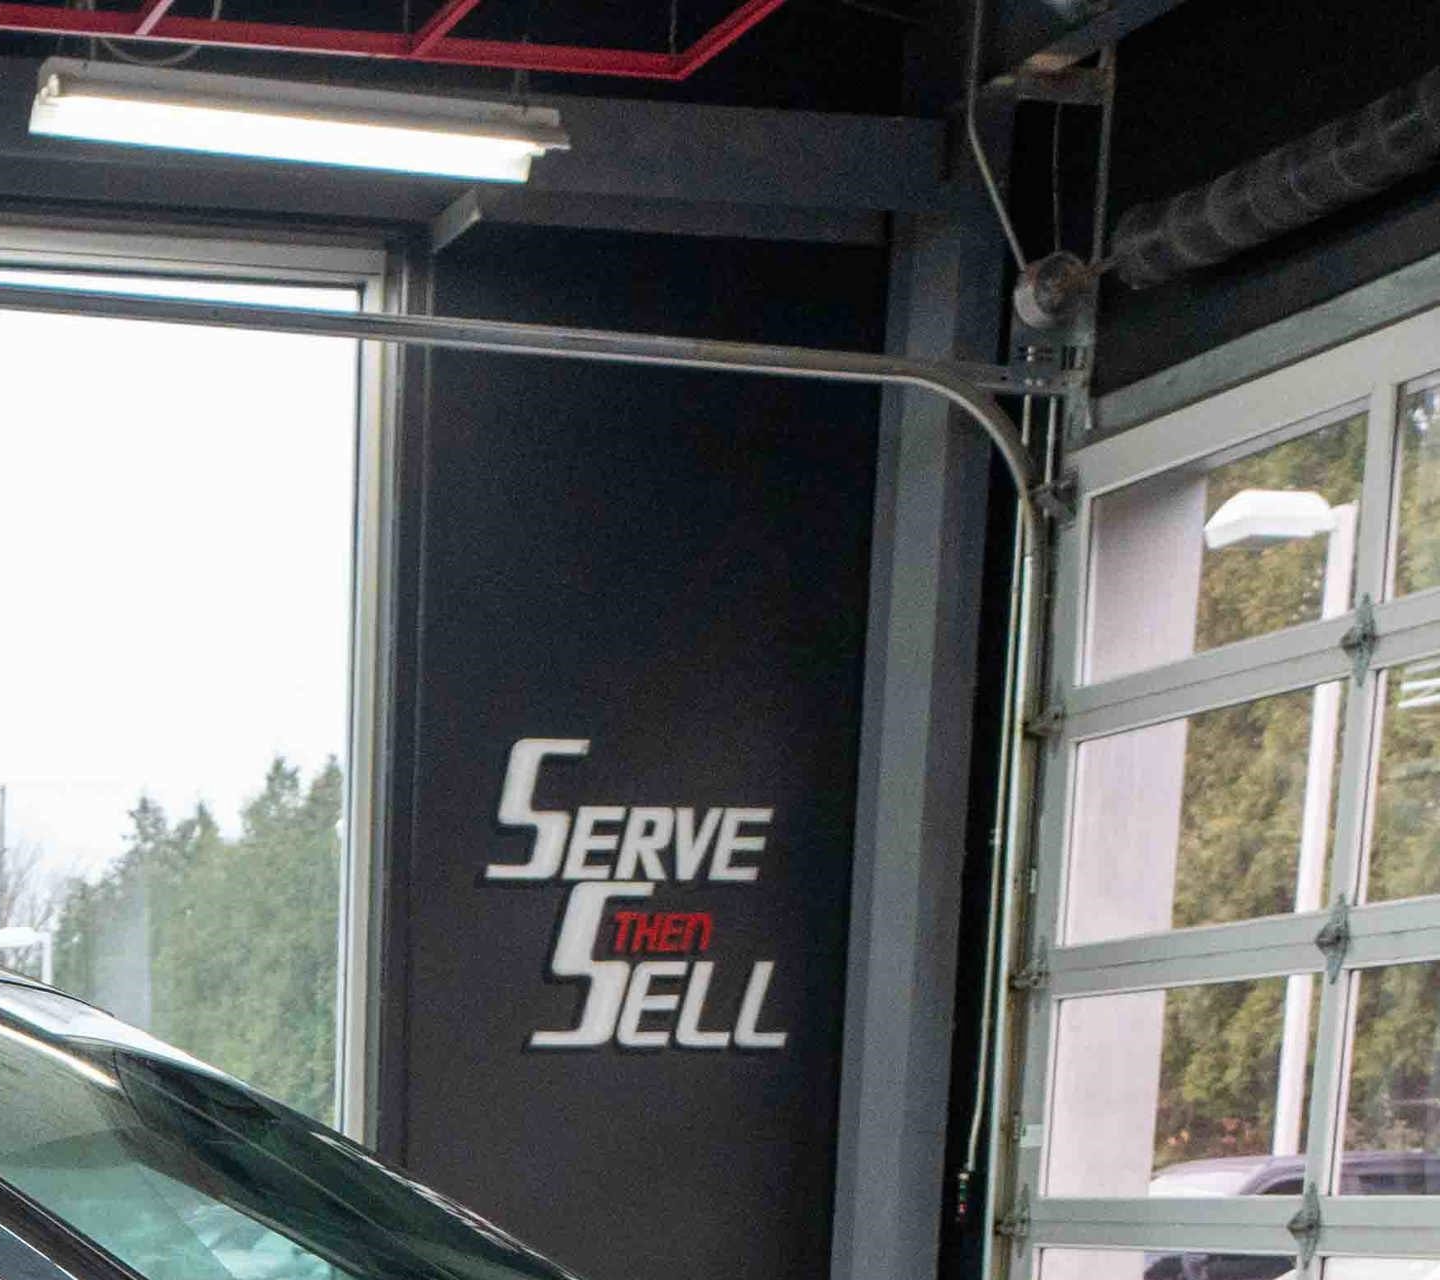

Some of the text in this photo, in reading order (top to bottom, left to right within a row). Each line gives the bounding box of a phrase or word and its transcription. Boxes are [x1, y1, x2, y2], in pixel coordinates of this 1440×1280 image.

[485, 738, 774, 880] SERVE
[530, 881, 788, 1047] SELL
[614, 911, 714, 952] THEN
